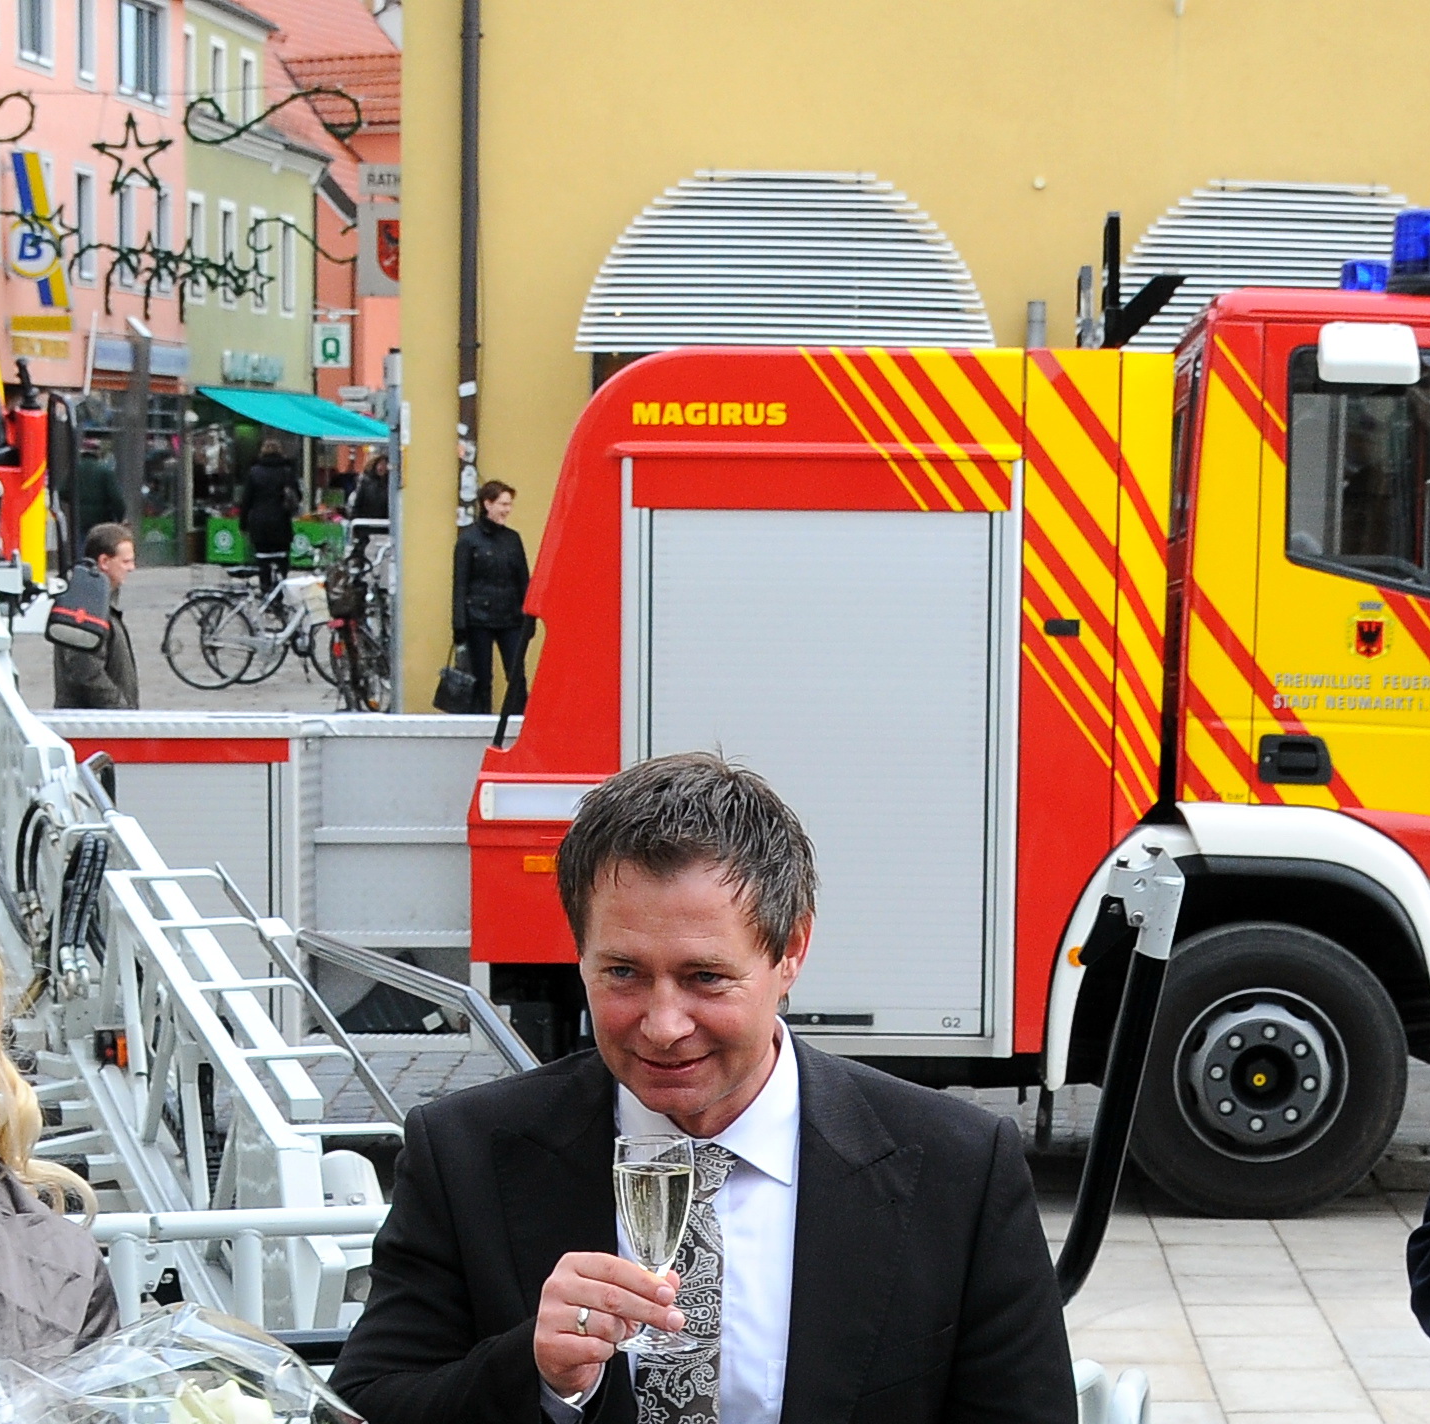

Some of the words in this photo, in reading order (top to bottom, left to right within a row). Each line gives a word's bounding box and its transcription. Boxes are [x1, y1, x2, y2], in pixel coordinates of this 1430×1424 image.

[632, 401, 787, 426] MAGIRUS
[1274, 673, 1371, 689] FREIWILLIGE
[1273, 693, 1318, 710] STADT
[1325, 695, 1413, 711] NEUMARKT
[941, 1016, 962, 1029] G2
